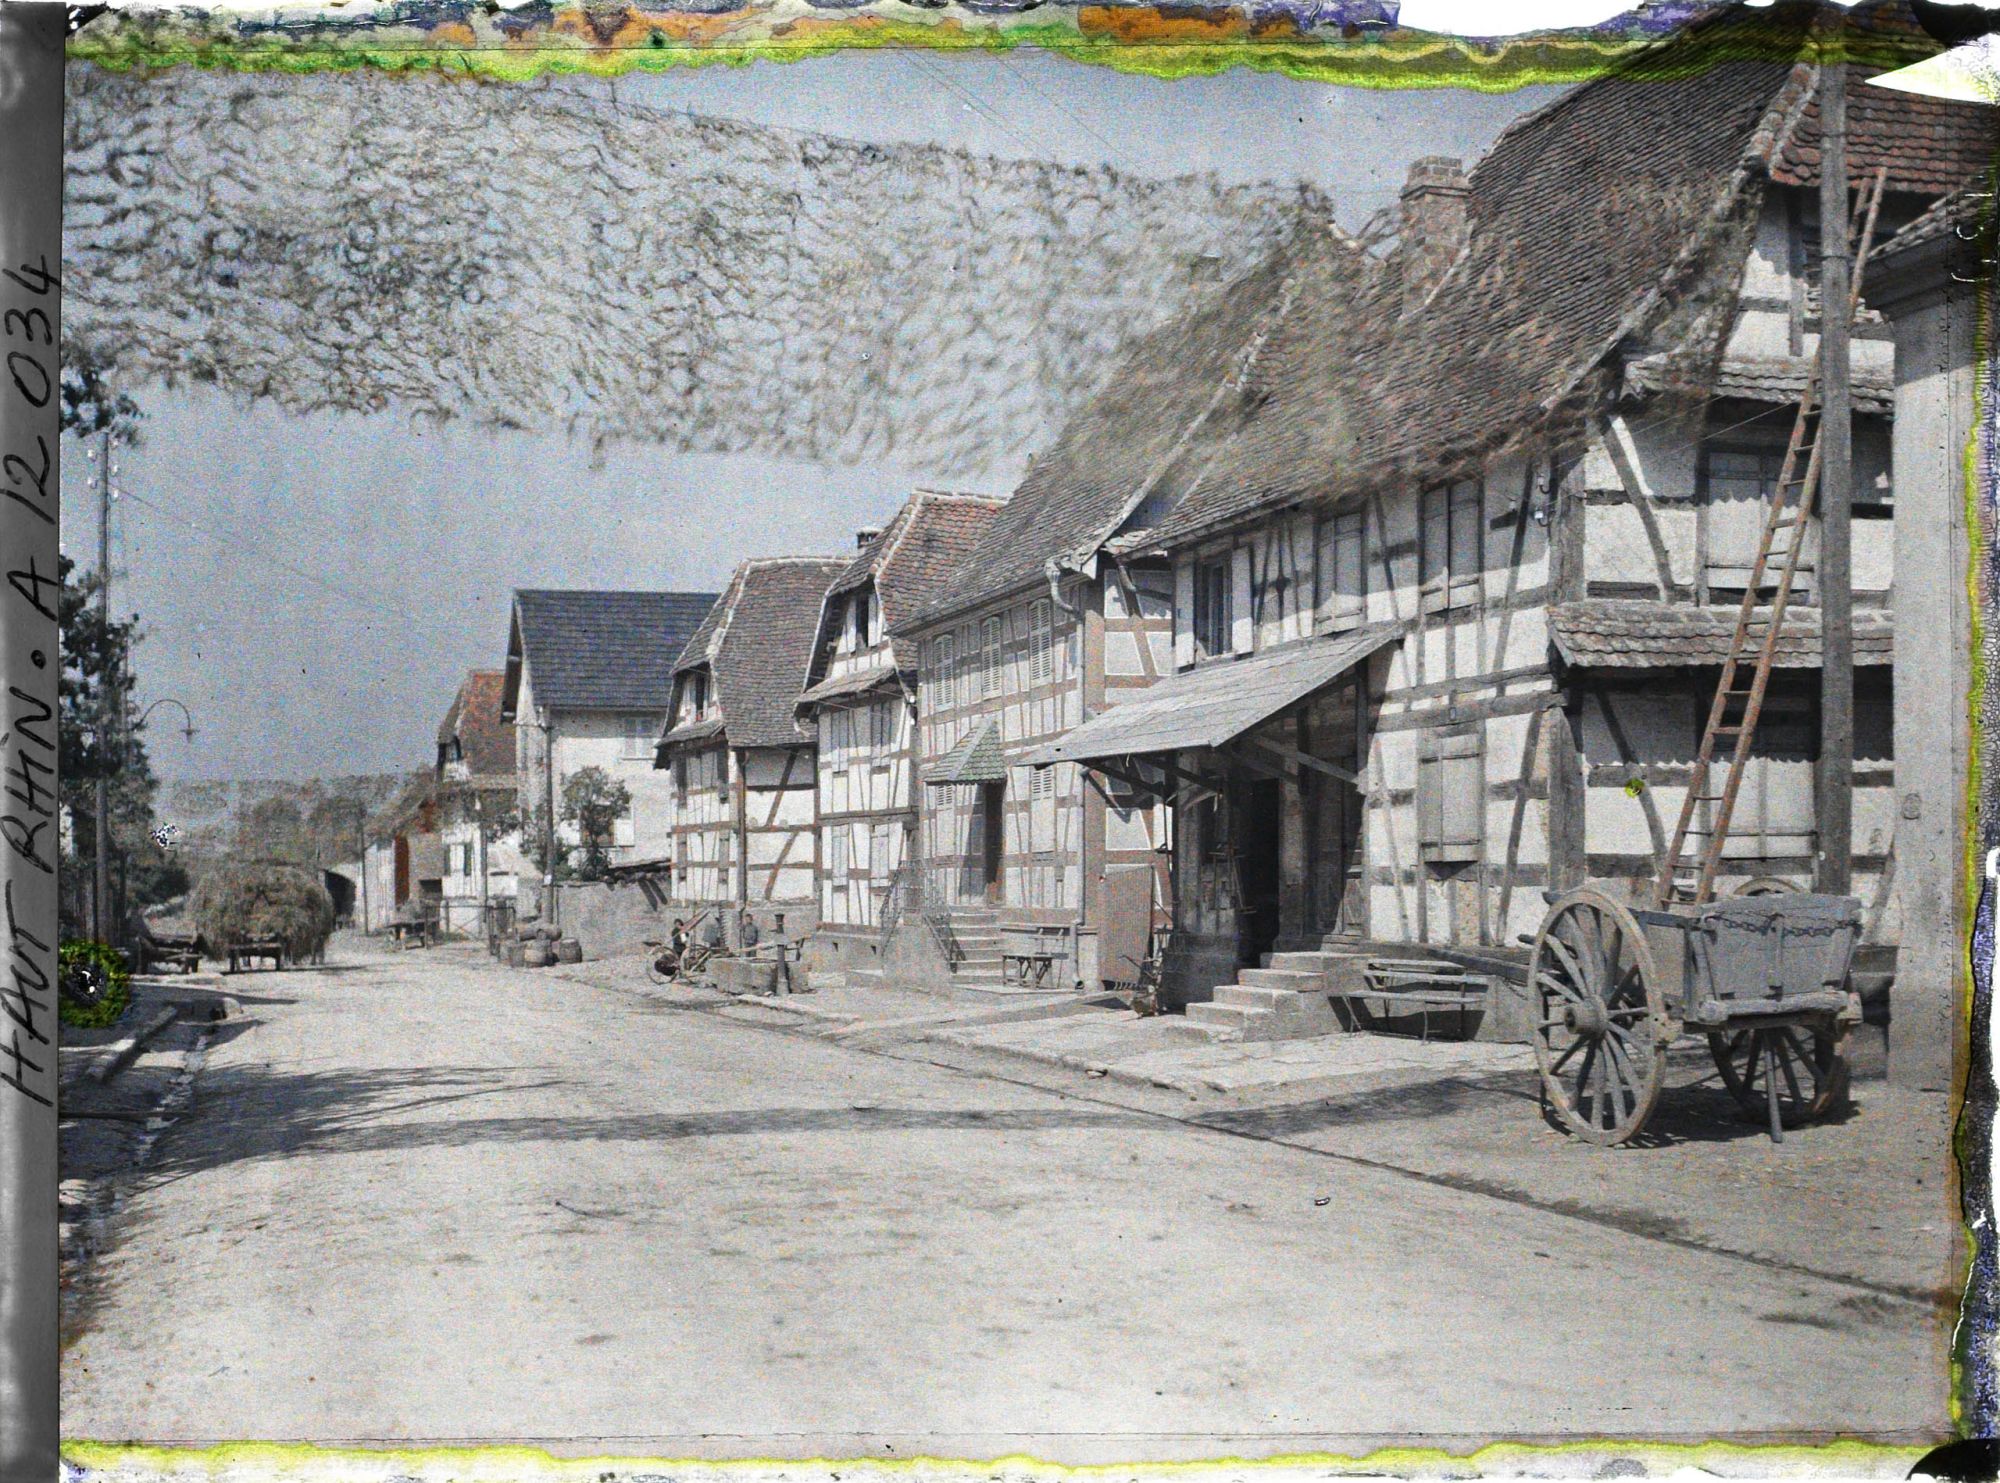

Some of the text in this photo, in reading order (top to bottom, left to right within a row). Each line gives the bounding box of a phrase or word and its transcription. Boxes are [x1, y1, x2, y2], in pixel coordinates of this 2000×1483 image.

[2, 254, 60, 408] 034
[0, 436, 56, 526] 12
[7, 556, 58, 622] A
[0, 880, 53, 1107] HAUT
